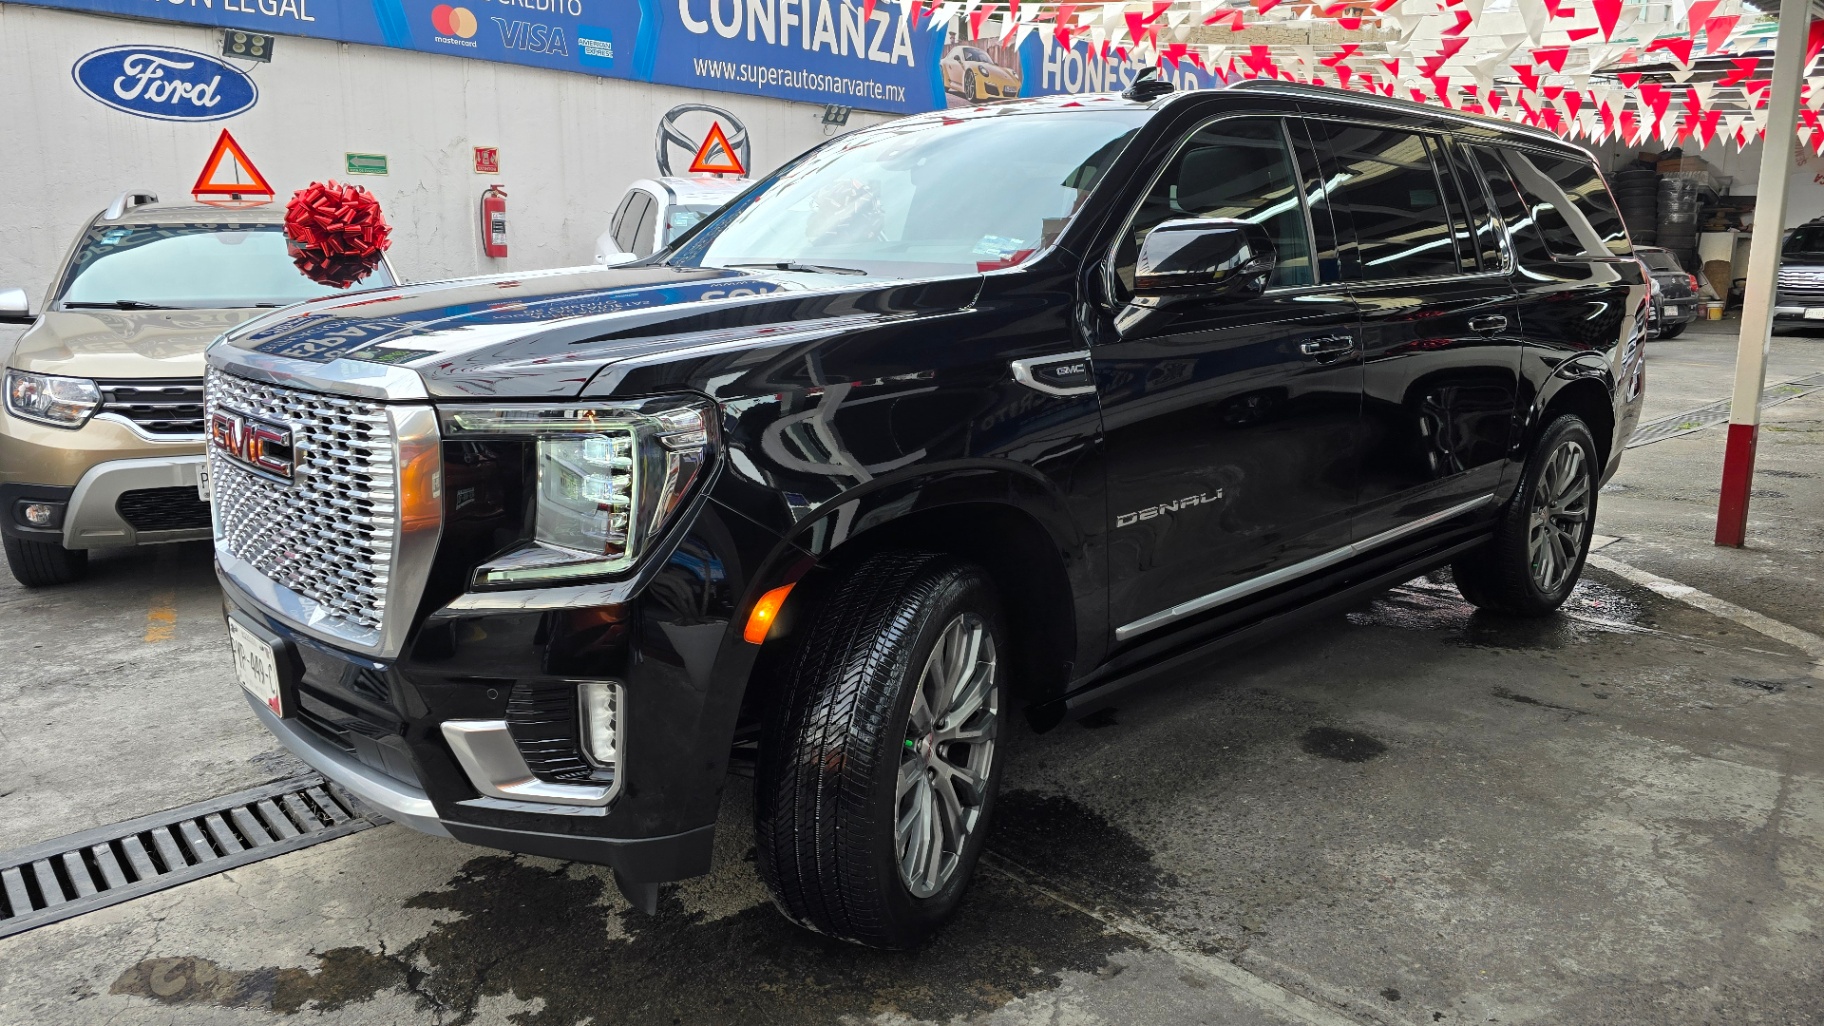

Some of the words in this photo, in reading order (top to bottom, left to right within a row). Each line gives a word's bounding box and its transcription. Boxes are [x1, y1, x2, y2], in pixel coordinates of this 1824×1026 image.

[434, 36, 477, 48] mastercard
[490, 16, 569, 57] VISA
[577, 37, 612, 50] AMERICAN
[679, 0, 915, 67] CONFIANZA
[113, 53, 221, 107] Ford
[693, 57, 906, 102] www.superautosnarvarte.mx
[1056, 363, 1085, 376] GMC
[212, 410, 290, 477] GMC
[1116, 487, 1223, 528] DENALI
